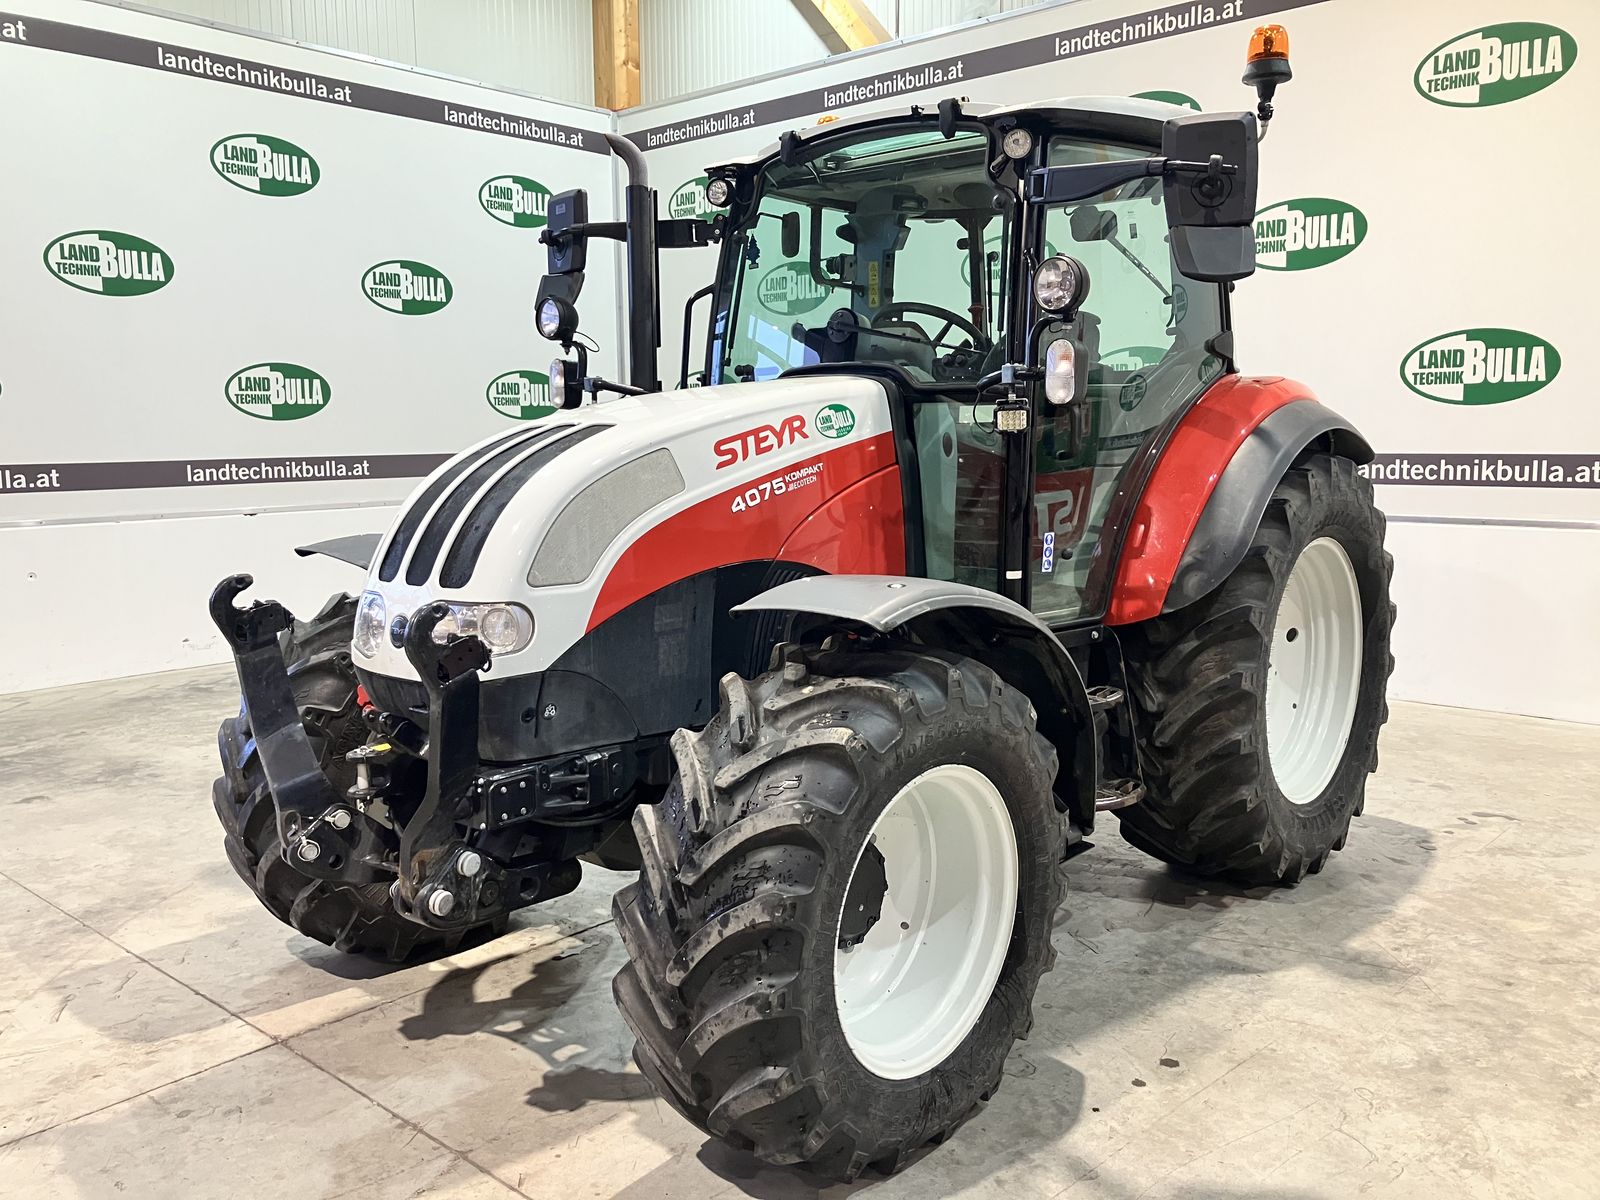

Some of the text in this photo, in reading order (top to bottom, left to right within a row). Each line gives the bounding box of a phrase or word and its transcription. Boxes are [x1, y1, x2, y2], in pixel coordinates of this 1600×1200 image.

[1055, 0, 1243, 56] landtechnikbulla.at
[1433, 48, 1481, 76] LAND
[1480, 35, 1563, 85] BULLA
[157, 46, 353, 103] landtechnikbulla.at
[823, 60, 965, 108] landtechnikbulla.at
[1426, 71, 1480, 93] TECHNIK
[444, 105, 584, 148] landtechnikbulla.at
[647, 109, 756, 147] landtechnikbulla.at
[223, 144, 258, 164] LAND
[256, 143, 313, 185] BULLA
[220, 161, 259, 178] TECHNIK
[488, 184, 513, 201] LAND
[676, 191, 696, 207] LAND
[486, 199, 514, 213] TECHNIK
[1255, 218, 1287, 239] AND
[1287, 209, 1356, 250] BULLA
[59, 243, 100, 263] LAND
[1255, 239, 1287, 255] CHNIK
[55, 261, 102, 277] TECHNIK
[98, 239, 166, 282] BULLA
[372, 271, 401, 287] LAND
[400, 267, 447, 303] BULLA
[765, 276, 788, 292] LAND
[369, 287, 402, 300] TECHNIK
[762, 292, 788, 304] TECHNIK
[1418, 349, 1465, 370] LAND
[1464, 340, 1546, 384] BULLA
[237, 376, 271, 392] LAND
[270, 370, 323, 406] BULLA
[495, 382, 520, 396] LAND
[1412, 371, 1464, 386] TECHNIK
[234, 393, 272, 405] TECHNIK
[519, 377, 553, 408] BULL
[713, 414, 810, 470] STEYR
[186, 460, 370, 482] landtechnikbulla.at
[1357, 458, 1600, 484] andtechnikbulla.at
[731, 462, 824, 513] 4075 KOMPAKT
[793, 474, 817, 490] ECOTECH
